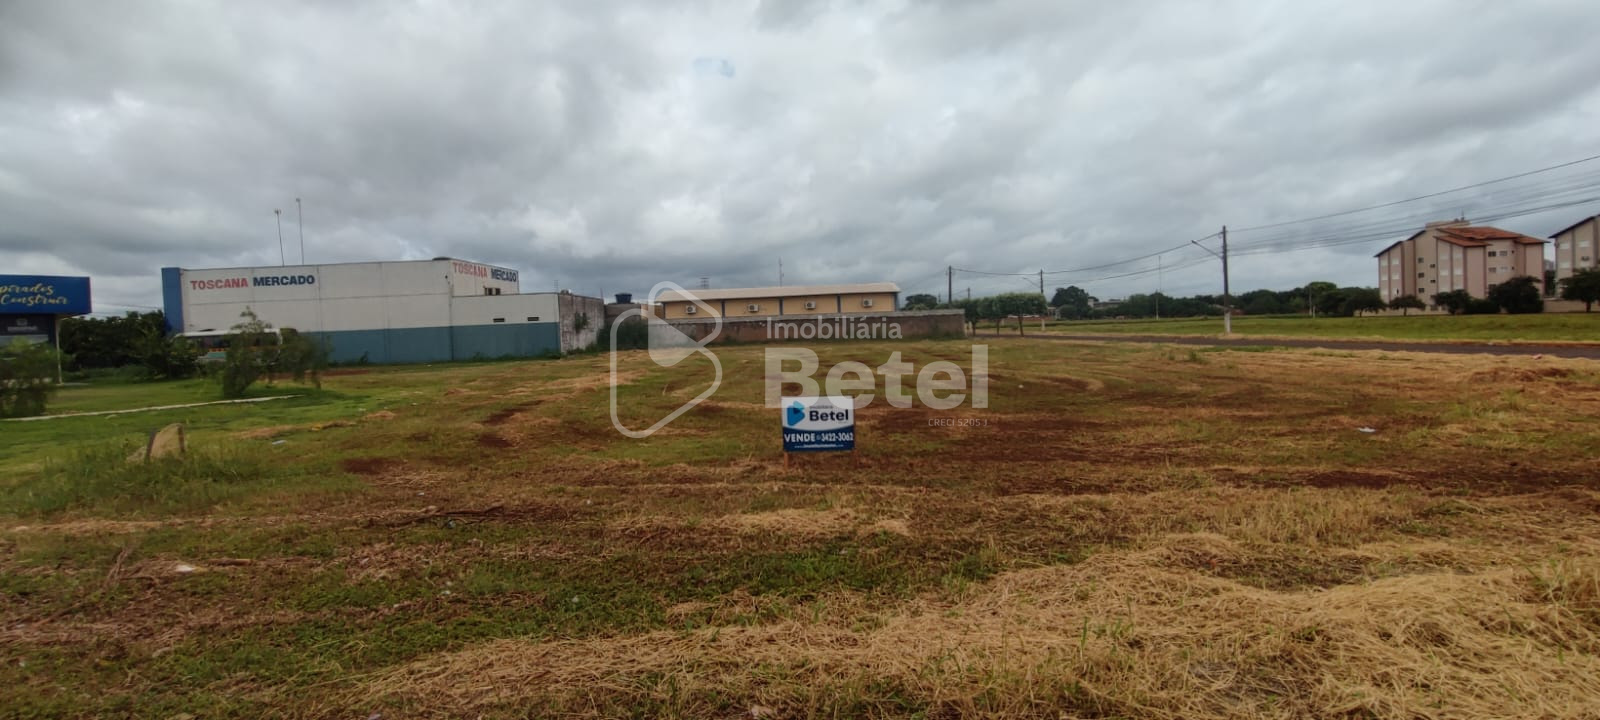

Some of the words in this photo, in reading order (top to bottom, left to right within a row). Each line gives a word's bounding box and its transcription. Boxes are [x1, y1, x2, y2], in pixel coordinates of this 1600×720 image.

[453, 261, 488, 278] TOSCANA
[490, 267, 517, 282] MERCADO
[190, 278, 249, 290] TOSCANA
[252, 275, 315, 287] MERCADO
[809, 409, 849, 421] Betel
[784, 432, 816, 442] VENDE
[821, 432, 854, 442] 3422-3062
